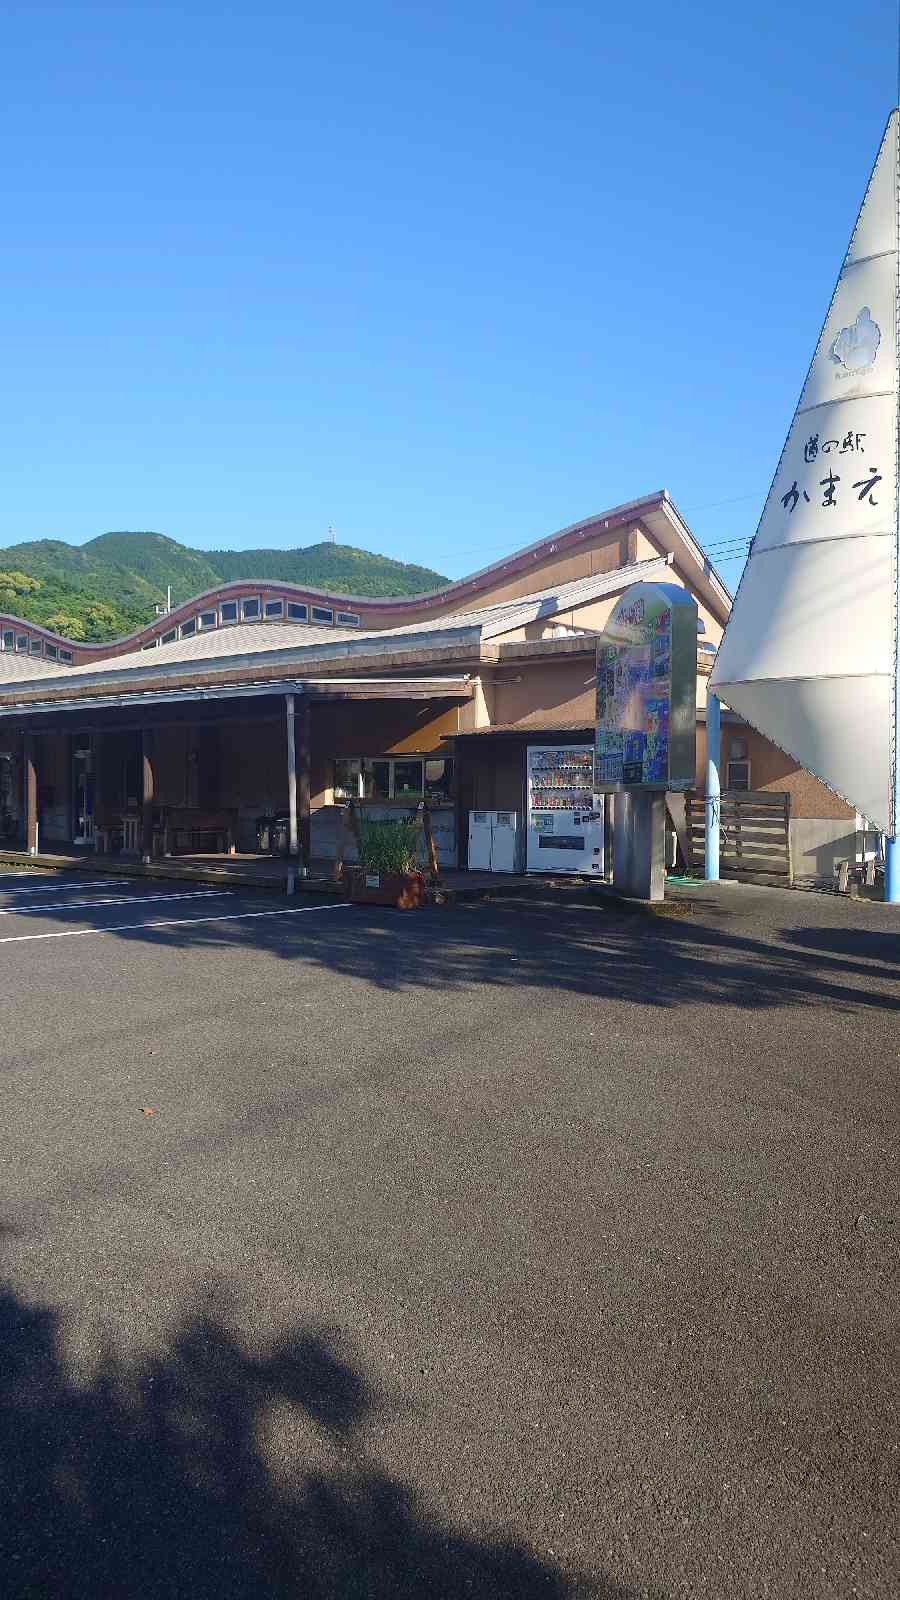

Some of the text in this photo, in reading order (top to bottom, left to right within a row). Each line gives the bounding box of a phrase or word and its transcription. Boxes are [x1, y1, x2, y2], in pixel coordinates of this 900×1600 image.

[804, 431, 866, 462] 道の駅
[781, 467, 882, 513] かまえ
